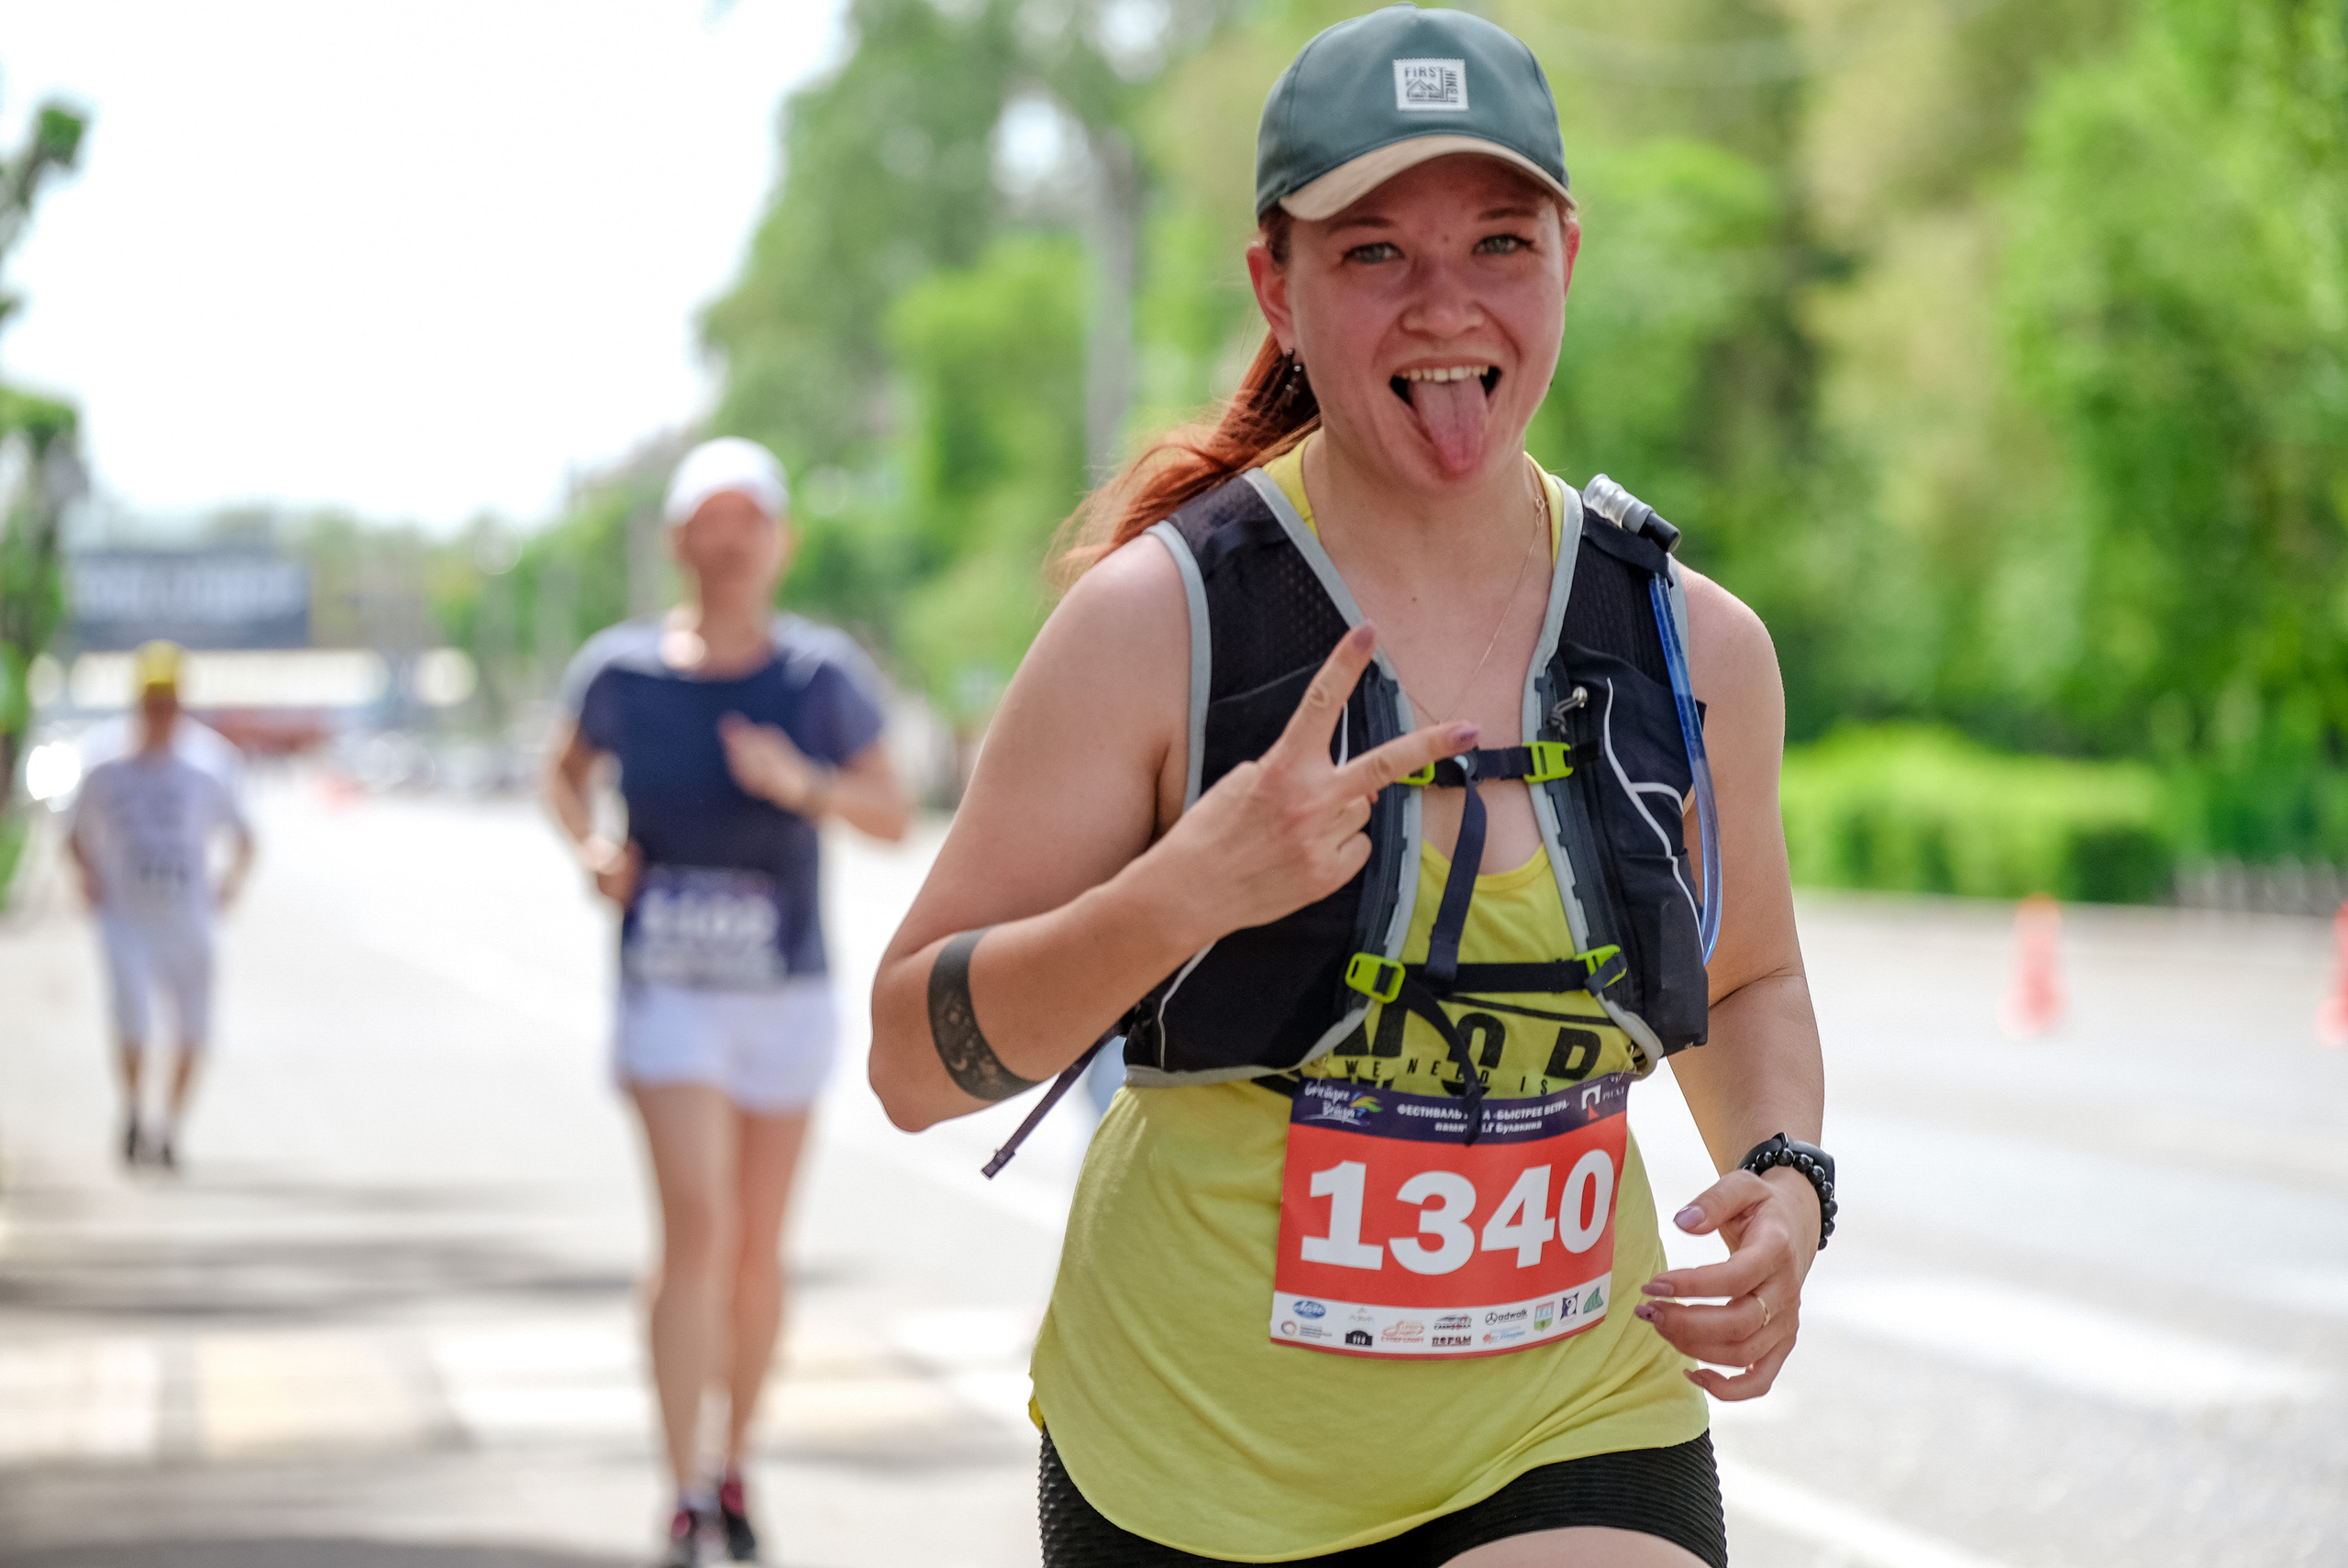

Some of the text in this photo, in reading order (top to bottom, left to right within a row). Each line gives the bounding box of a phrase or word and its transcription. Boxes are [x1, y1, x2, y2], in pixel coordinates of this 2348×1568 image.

[1346, 1059, 1381, 1078] WE
[1520, 1076, 1548, 1095] IS
[1397, 1103, 1463, 1120] ФЕСТИВАЛЬ
[1434, 1121, 1468, 1133] памя
[1301, 1149, 1614, 1275] 1340
